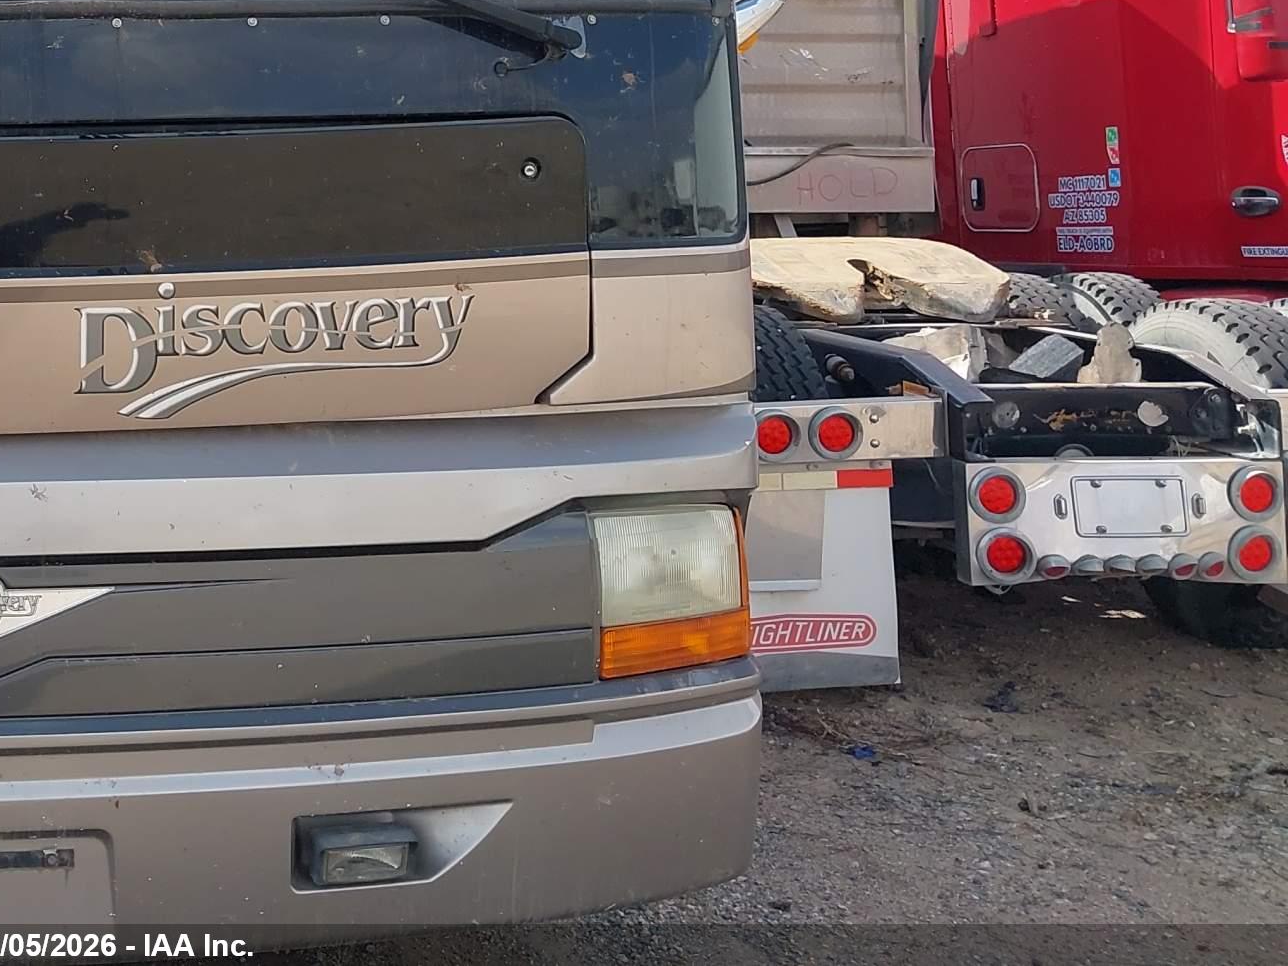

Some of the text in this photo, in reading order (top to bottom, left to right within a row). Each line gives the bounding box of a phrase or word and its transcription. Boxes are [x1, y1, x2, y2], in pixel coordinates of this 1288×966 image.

[797, 167, 899, 205] HOLD
[1048, 194, 1077, 207] USDOT
[74, 281, 475, 396] Discovery
[751, 622, 866, 646] IGHTLINER
